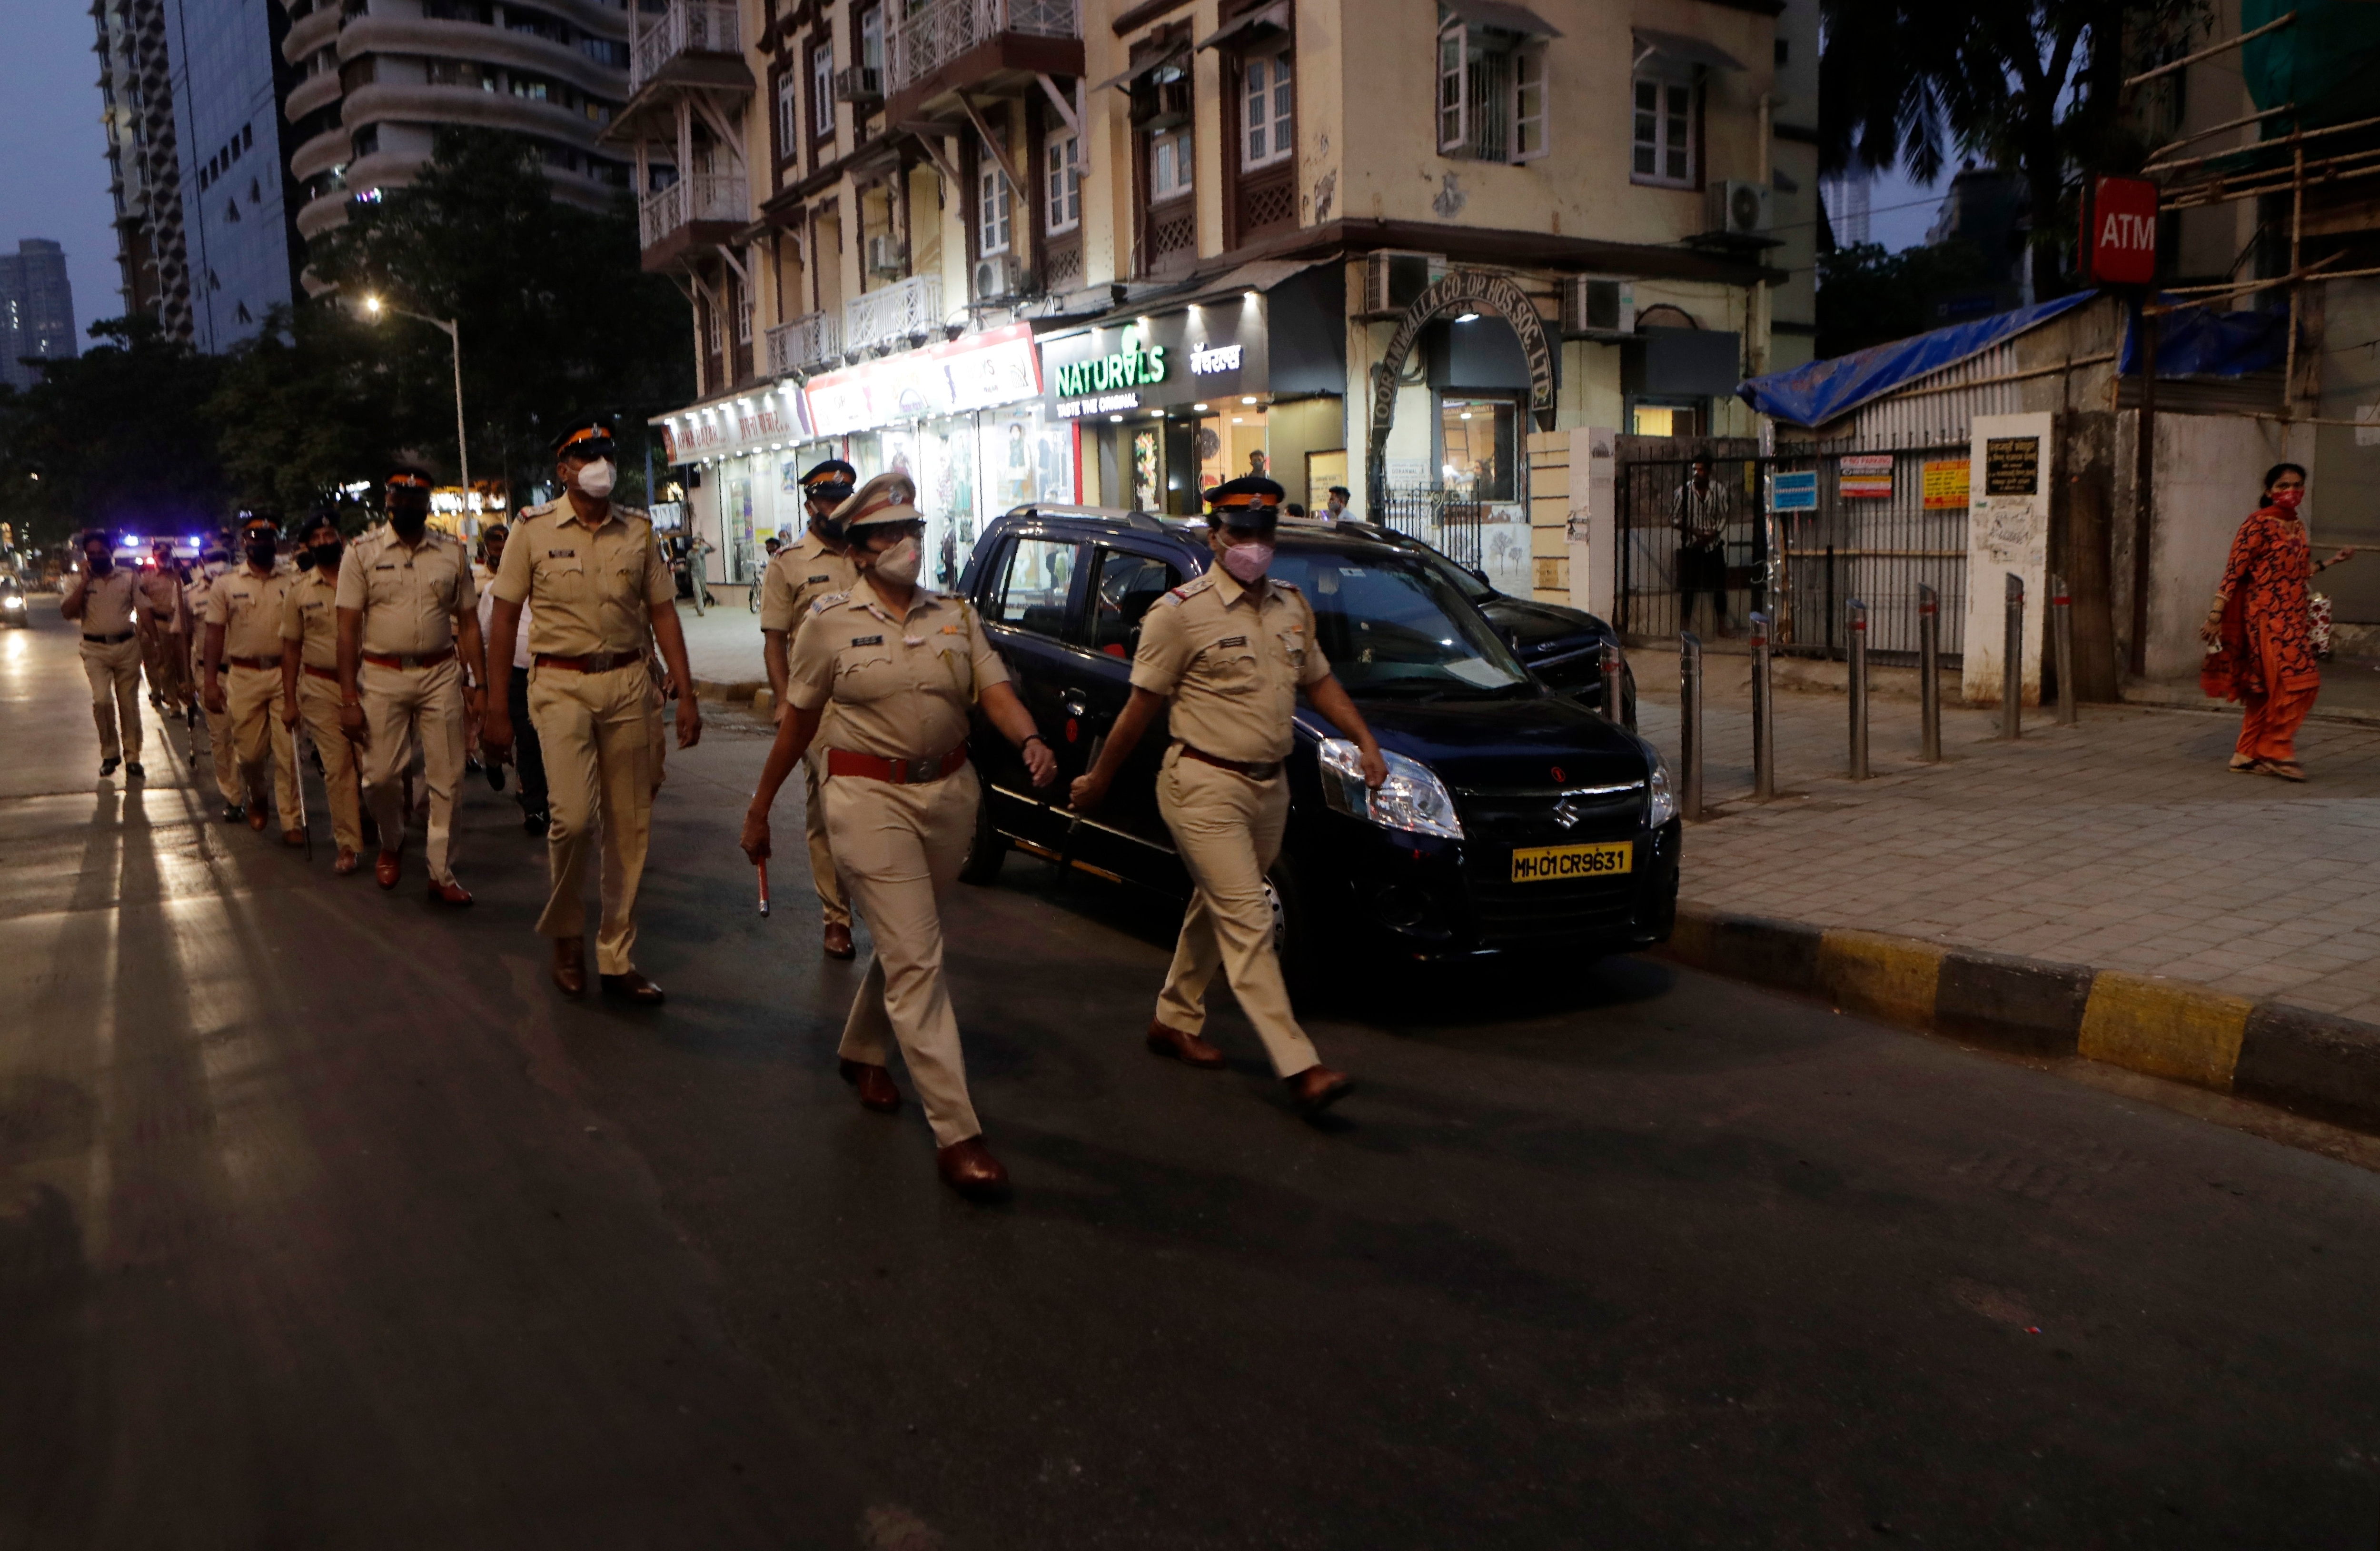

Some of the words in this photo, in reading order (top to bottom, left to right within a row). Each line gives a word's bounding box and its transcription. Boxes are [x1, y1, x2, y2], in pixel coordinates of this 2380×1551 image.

[2099, 212, 2155, 251] ATM
[1055, 345, 1165, 398] NATURALS
[1056, 401, 1081, 418] TASTE
[1081, 398, 1098, 415] THE
[1098, 392, 1139, 413] ORIGINAL
[677, 429, 695, 451] APNA
[695, 425, 718, 447] BAZAR
